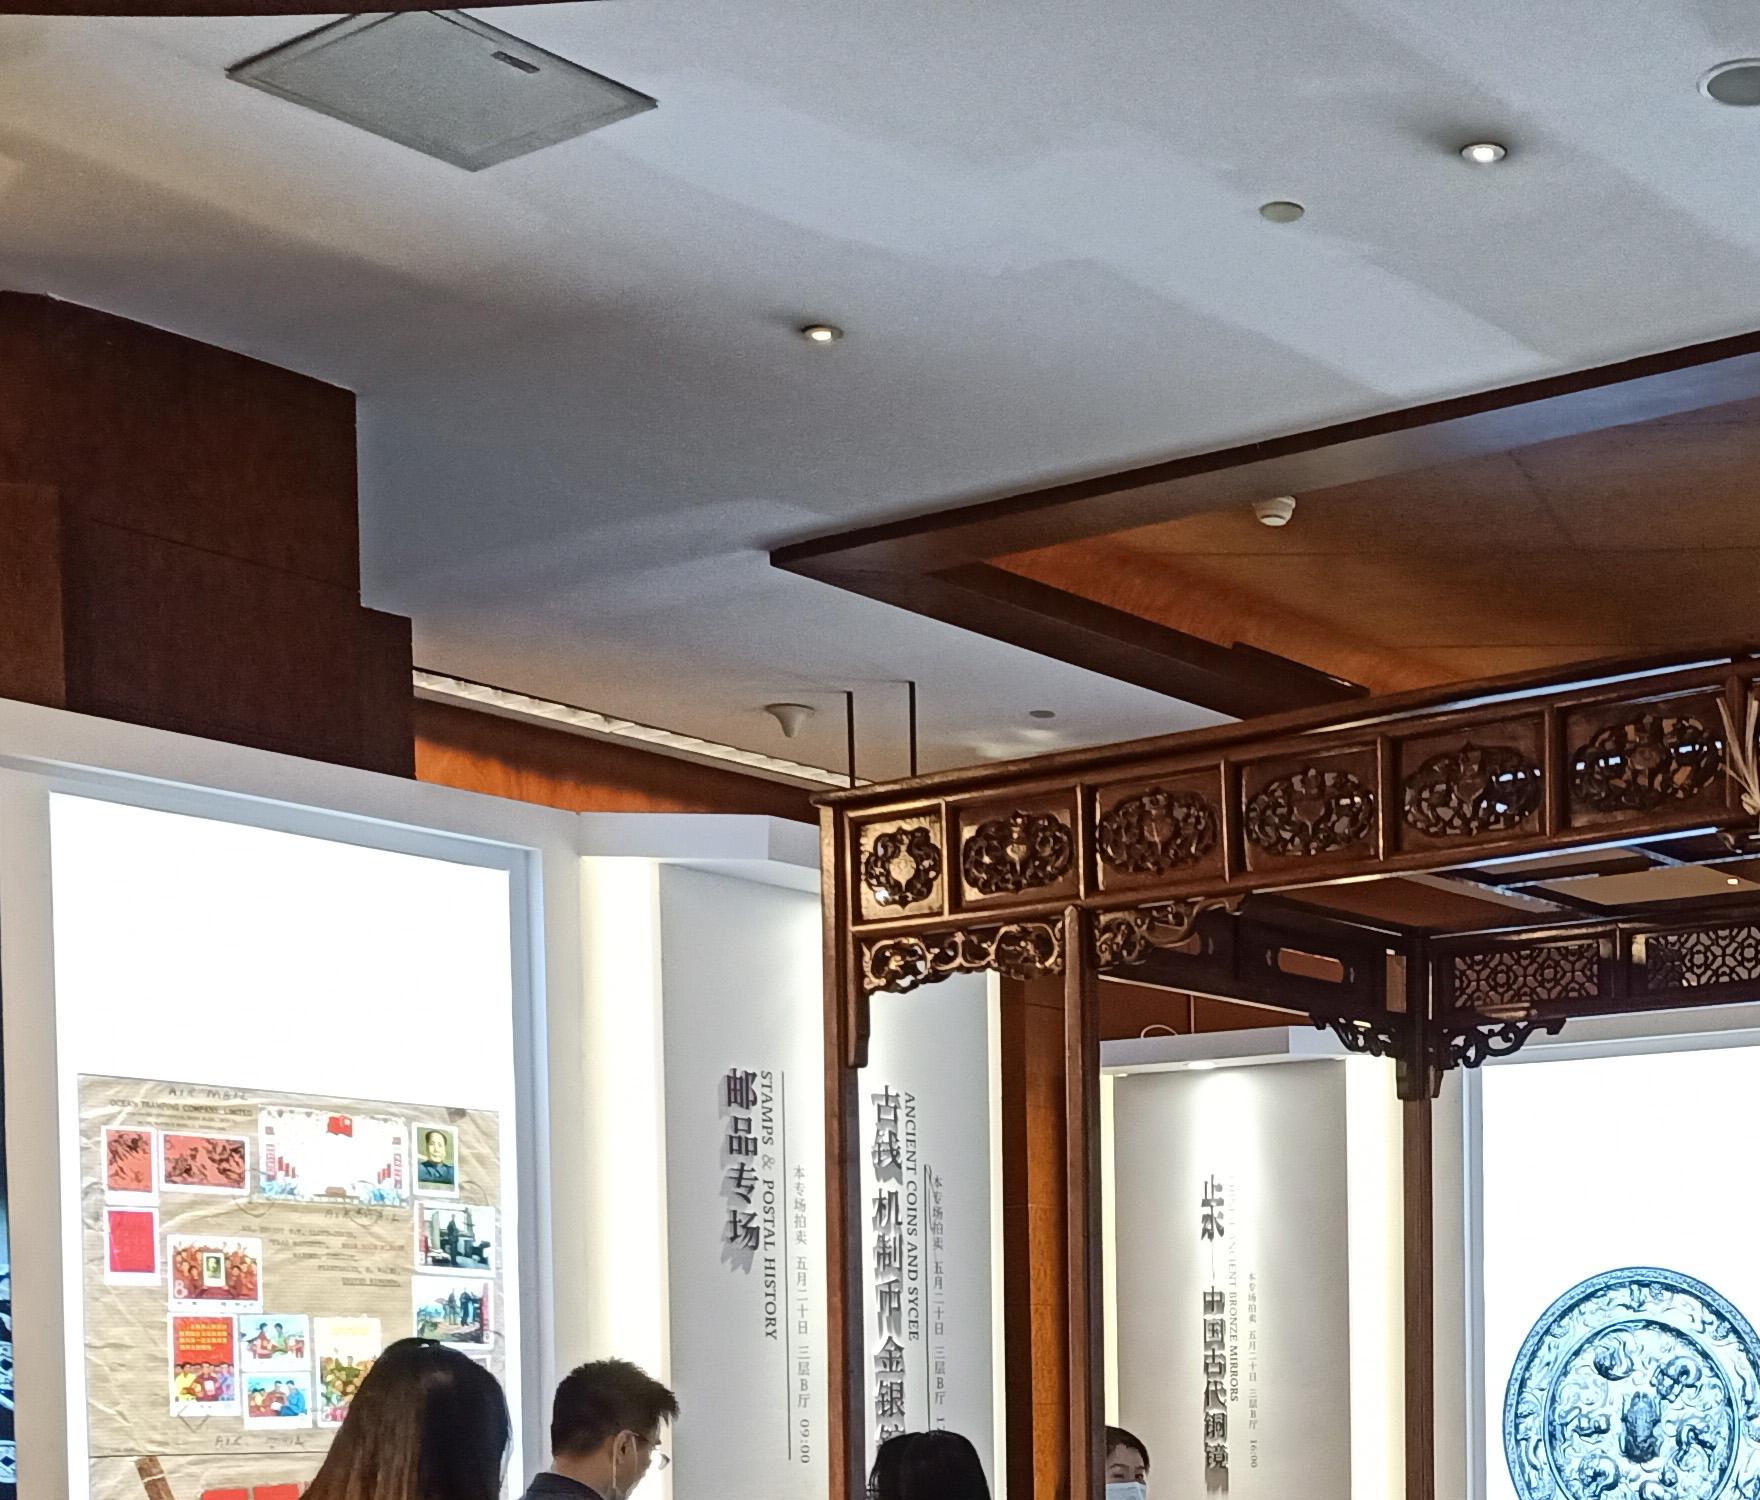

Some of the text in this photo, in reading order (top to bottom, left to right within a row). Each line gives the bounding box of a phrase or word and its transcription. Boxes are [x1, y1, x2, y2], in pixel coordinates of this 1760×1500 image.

[726, 1068, 760, 1250] 邮品专场
[761, 1070, 777, 1340] STAMPS & POSTAL HISTORY
[905, 1092, 919, 1341] ANCIENT COINS AND SYCEE
[796, 1256, 809, 1334] 五月二十日
[933, 1261, 945, 1335] 五月二十日
[1229, 1292, 1238, 1342] BRONZE
[1230, 1345, 1239, 1401] MIRRORS
[799, 1418, 811, 1463] 09:00
